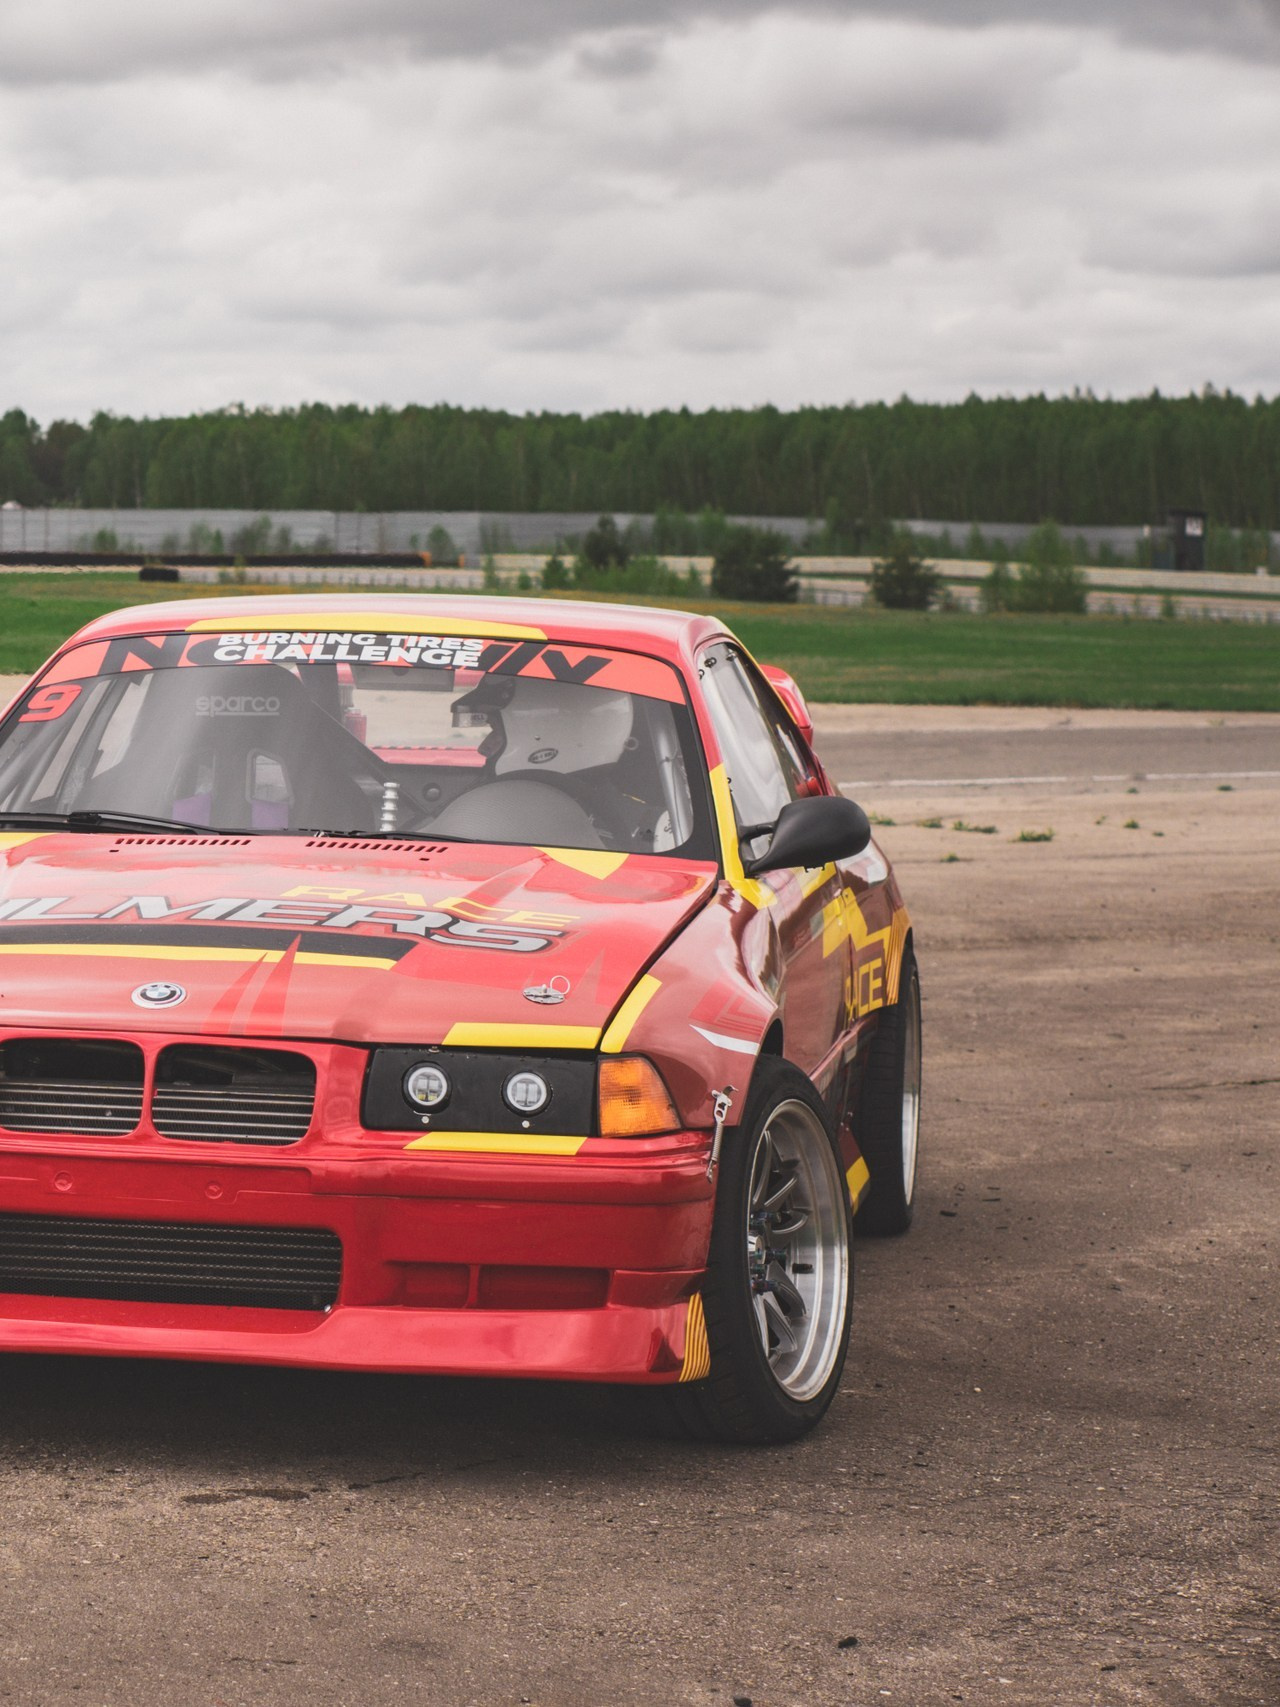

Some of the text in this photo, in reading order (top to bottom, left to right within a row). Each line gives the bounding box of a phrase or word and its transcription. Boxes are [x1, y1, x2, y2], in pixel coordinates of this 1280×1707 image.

[217, 632, 484, 651] BURNING TIRES
[213, 643, 482, 668] CHALLENGE
[17, 683, 83, 723] 9
[194, 694, 281, 717] sparco
[279, 884, 582, 928] RACE
